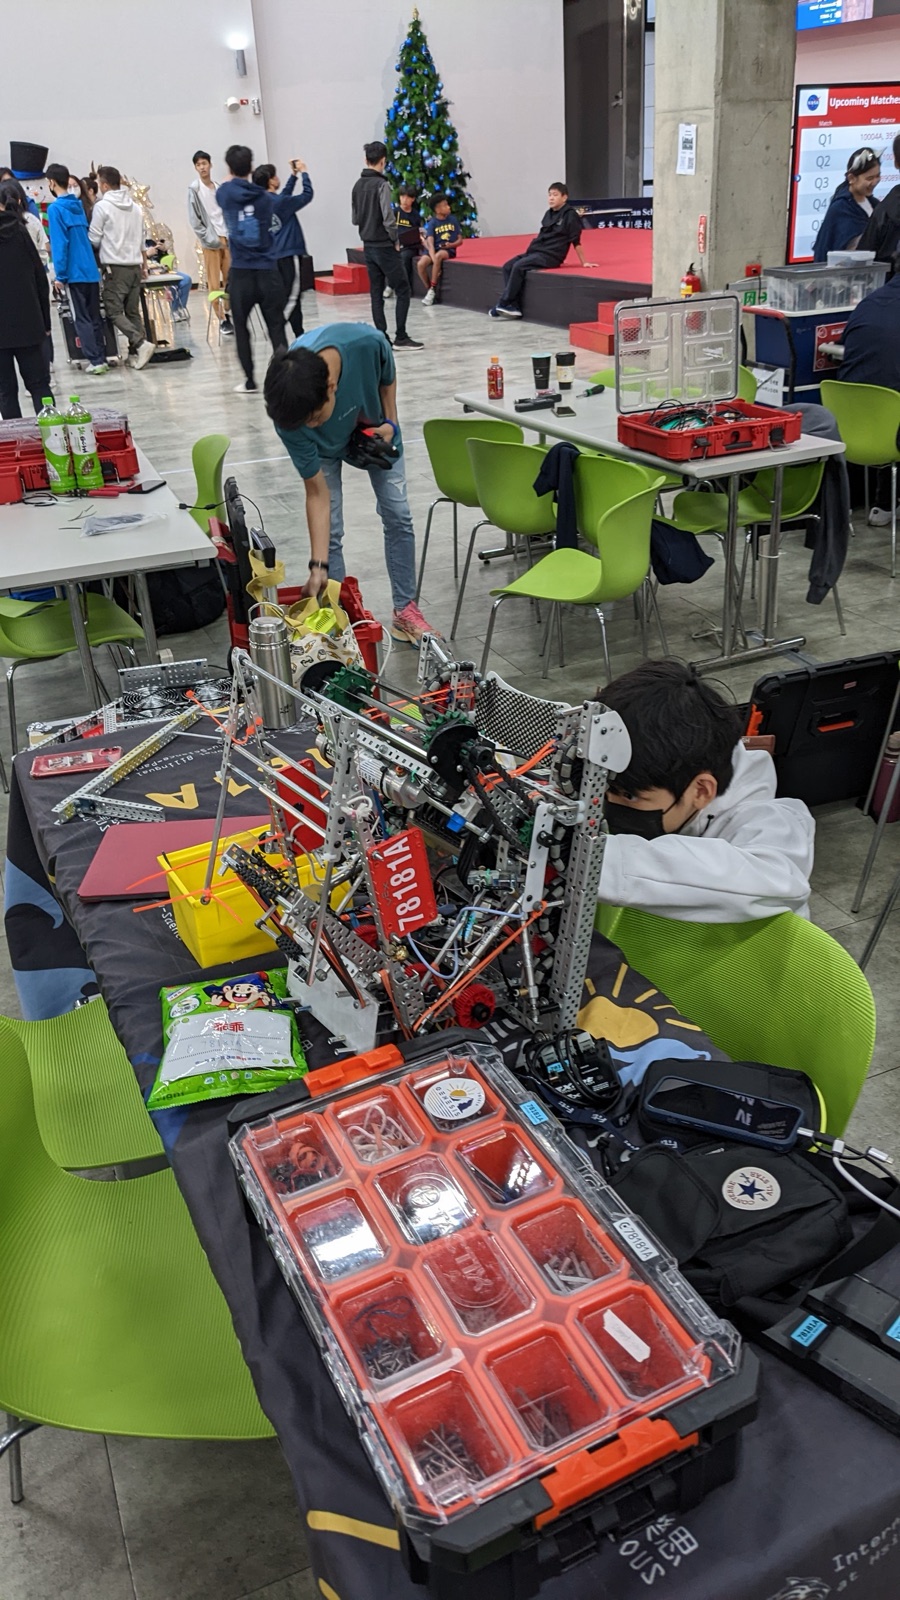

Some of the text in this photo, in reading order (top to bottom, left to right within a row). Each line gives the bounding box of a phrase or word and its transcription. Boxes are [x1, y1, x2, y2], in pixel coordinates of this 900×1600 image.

[829, 97, 869, 109] Upcoming
[818, 133, 832, 147] Q1
[816, 155, 831, 169] Q2
[815, 177, 829, 190] Q3
[813, 199, 827, 211] Q4
[811, 220, 822, 232] Q
[137, 755, 194, 777] Bilingual
[383, 836, 424, 932] 78181A
[797, 1319, 820, 1340] 78181A
